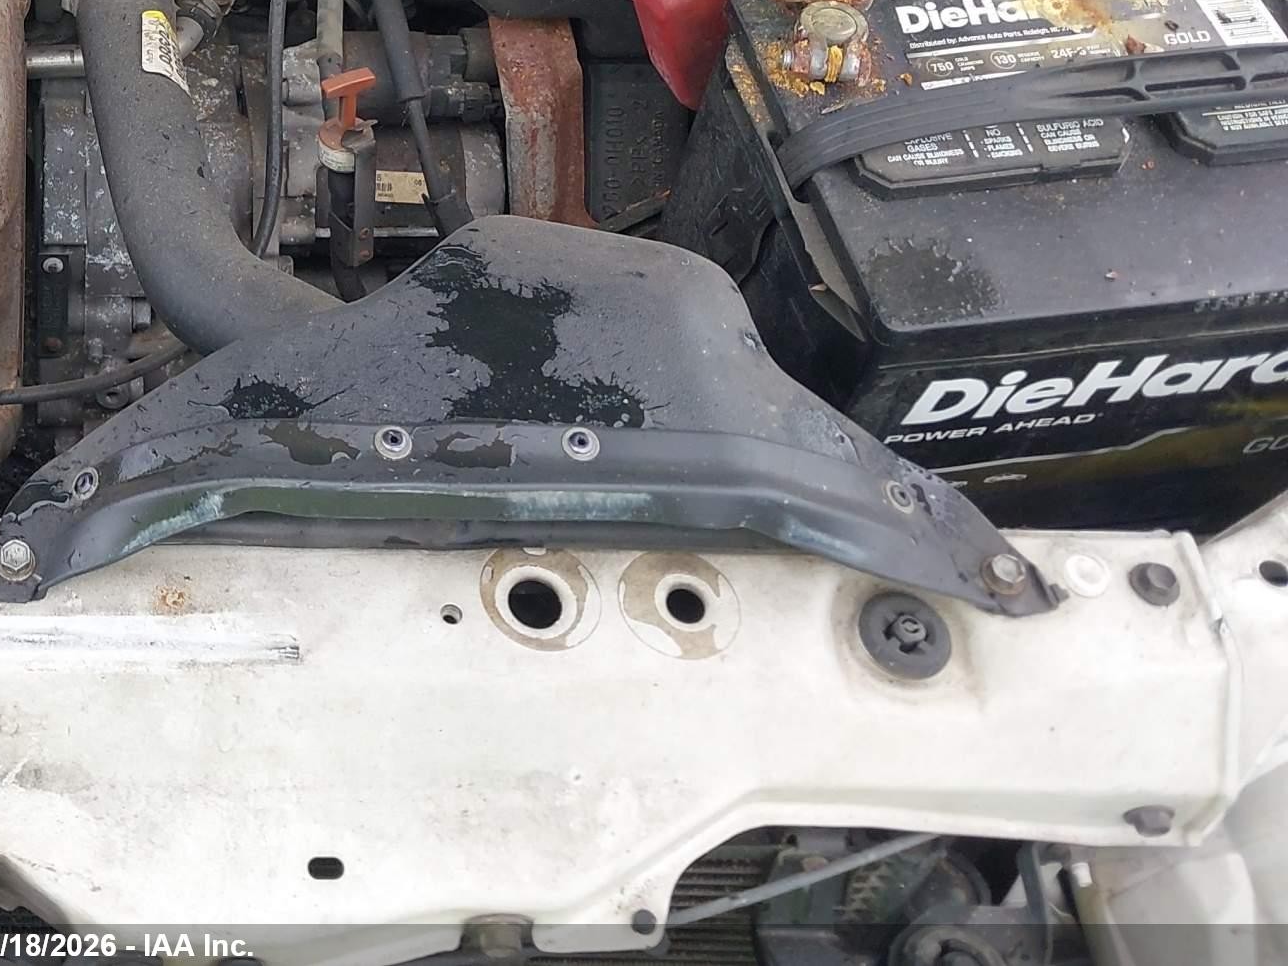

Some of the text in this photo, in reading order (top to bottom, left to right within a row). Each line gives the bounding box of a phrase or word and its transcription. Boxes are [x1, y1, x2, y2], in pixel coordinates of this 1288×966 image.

[909, 39, 946, 49] Distributed
[958, 34, 986, 43] Advance
[987, 32, 1002, 40] Auto
[1163, 30, 1211, 45] GOLD
[993, 53, 1017, 65] 130
[929, 61, 954, 73] 750
[985, 128, 1001, 137] NO
[1036, 119, 1103, 133] SULFURIC ACID
[906, 143, 938, 153] GASES
[883, 415, 1100, 444] POWER AHEAD
